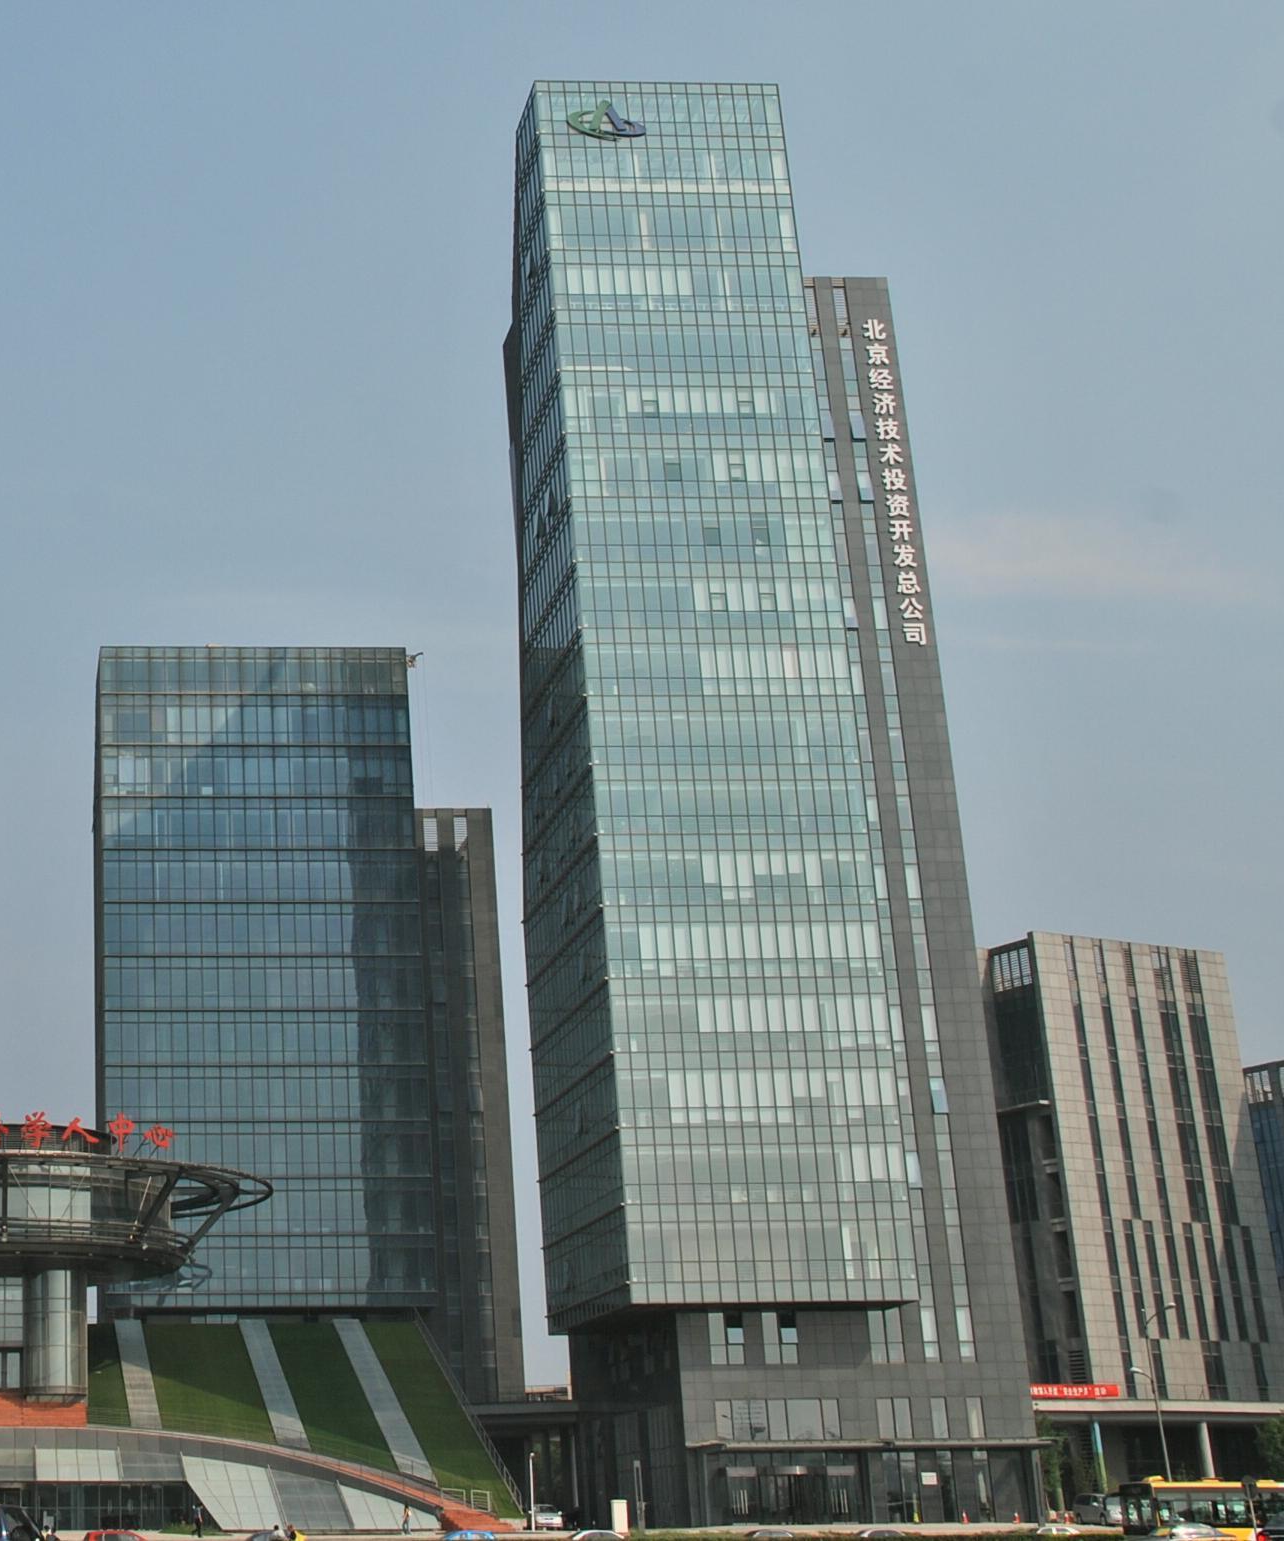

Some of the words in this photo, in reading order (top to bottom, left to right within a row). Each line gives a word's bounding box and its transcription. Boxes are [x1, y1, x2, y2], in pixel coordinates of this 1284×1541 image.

[863, 318, 928, 646] 北京经济技术投资开发总公司
